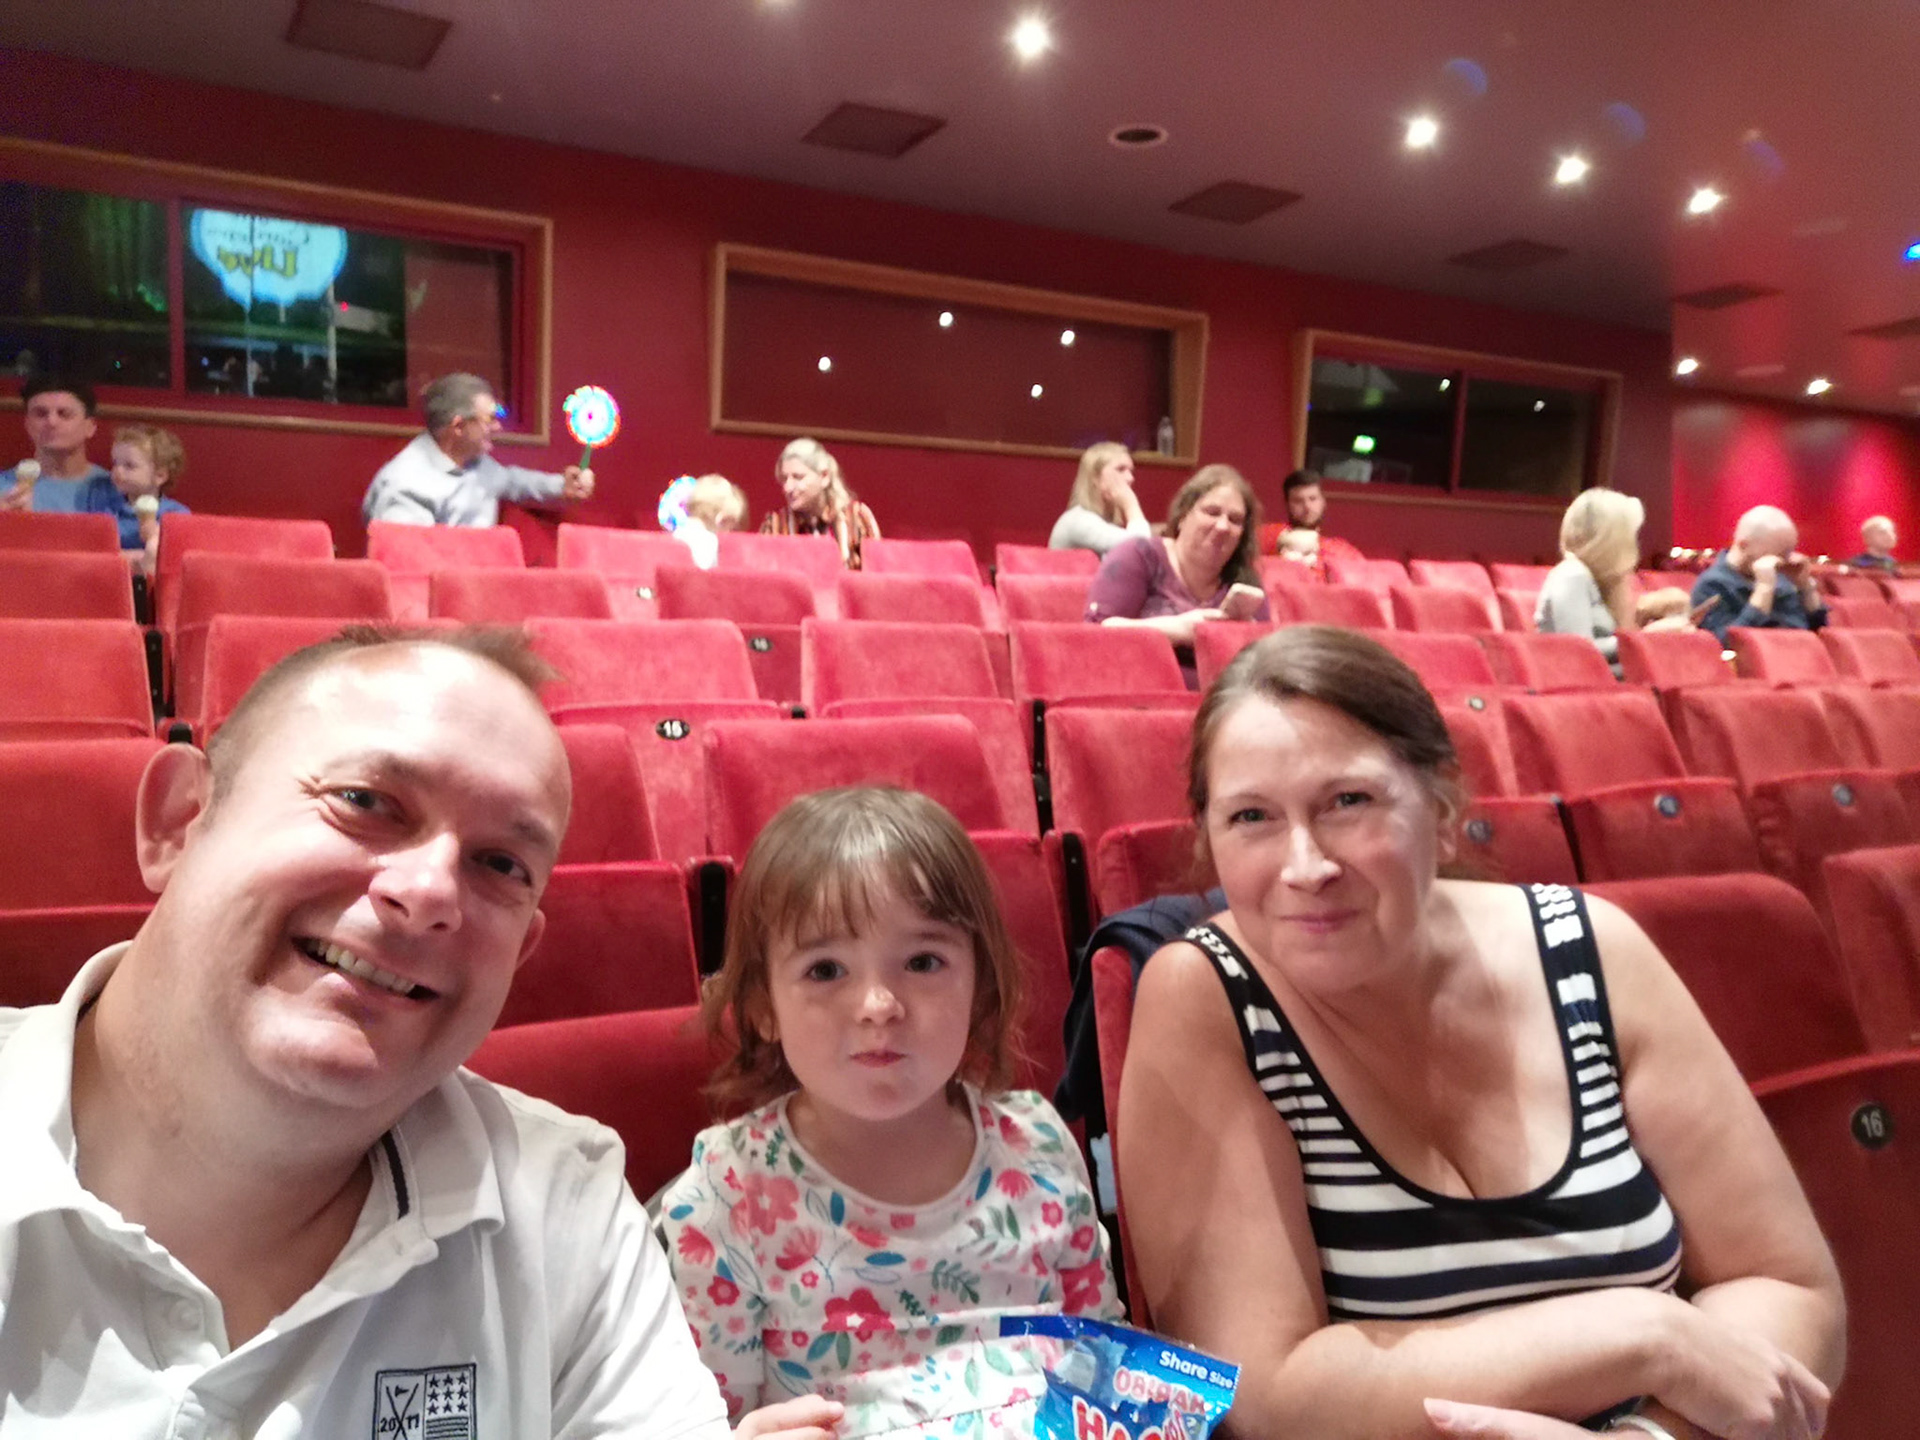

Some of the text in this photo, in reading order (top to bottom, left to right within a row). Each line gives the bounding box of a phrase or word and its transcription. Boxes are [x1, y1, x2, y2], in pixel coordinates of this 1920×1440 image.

[1861, 1110, 1883, 1137] 16
[1159, 1350, 1234, 1390] Share size
